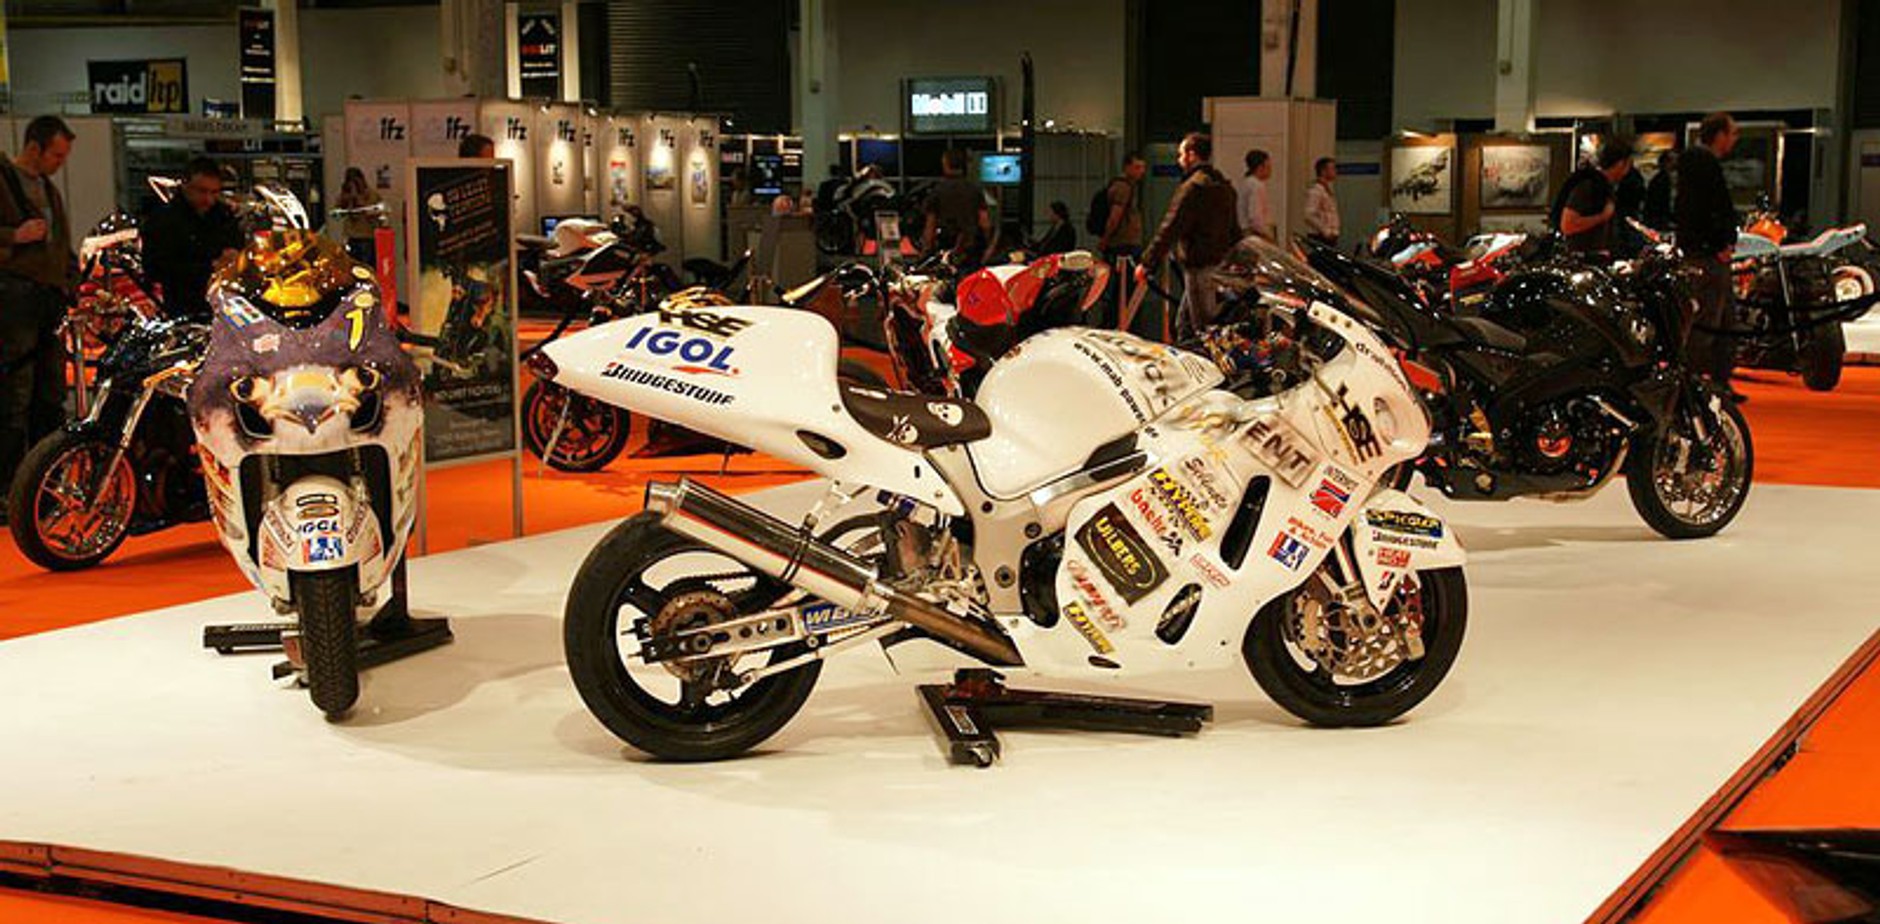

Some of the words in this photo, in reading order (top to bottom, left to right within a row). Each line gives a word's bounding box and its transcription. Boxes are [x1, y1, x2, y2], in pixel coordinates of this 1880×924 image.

[94, 71, 146, 105] raid
[911, 93, 965, 116] Mobil
[381, 116, 404, 140] ifz
[507, 117, 527, 140] ifz
[558, 120, 576, 142] ifz
[625, 327, 736, 371] IGOL
[602, 362, 735, 406] BRIDGESTONE
[1095, 516, 1141, 576] WILBERS
